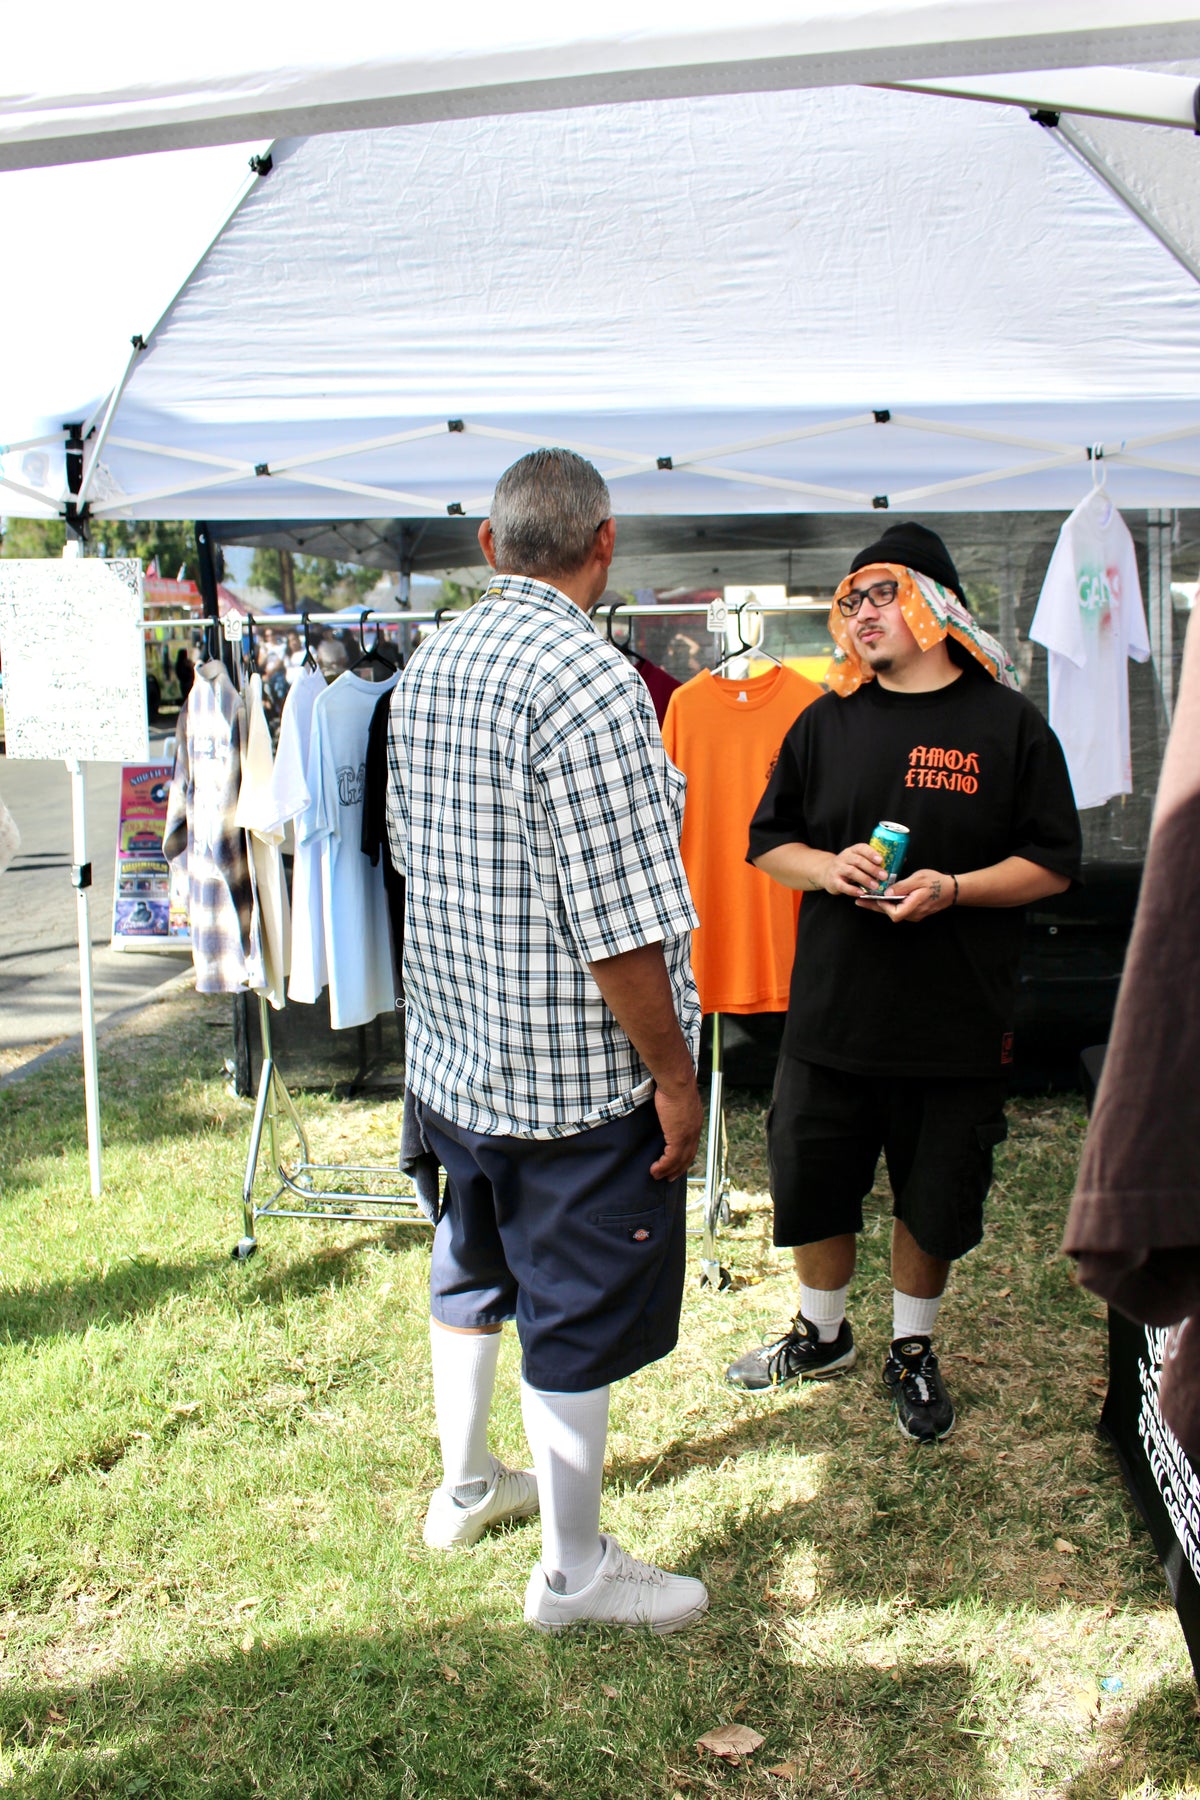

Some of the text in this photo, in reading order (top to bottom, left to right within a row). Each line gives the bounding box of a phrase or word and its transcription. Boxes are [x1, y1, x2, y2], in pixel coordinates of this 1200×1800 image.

[908, 745, 980, 774] AMOR
[904, 768, 978, 795] ETERNO
[1141, 1394, 1200, 1543] STREETWEAR
